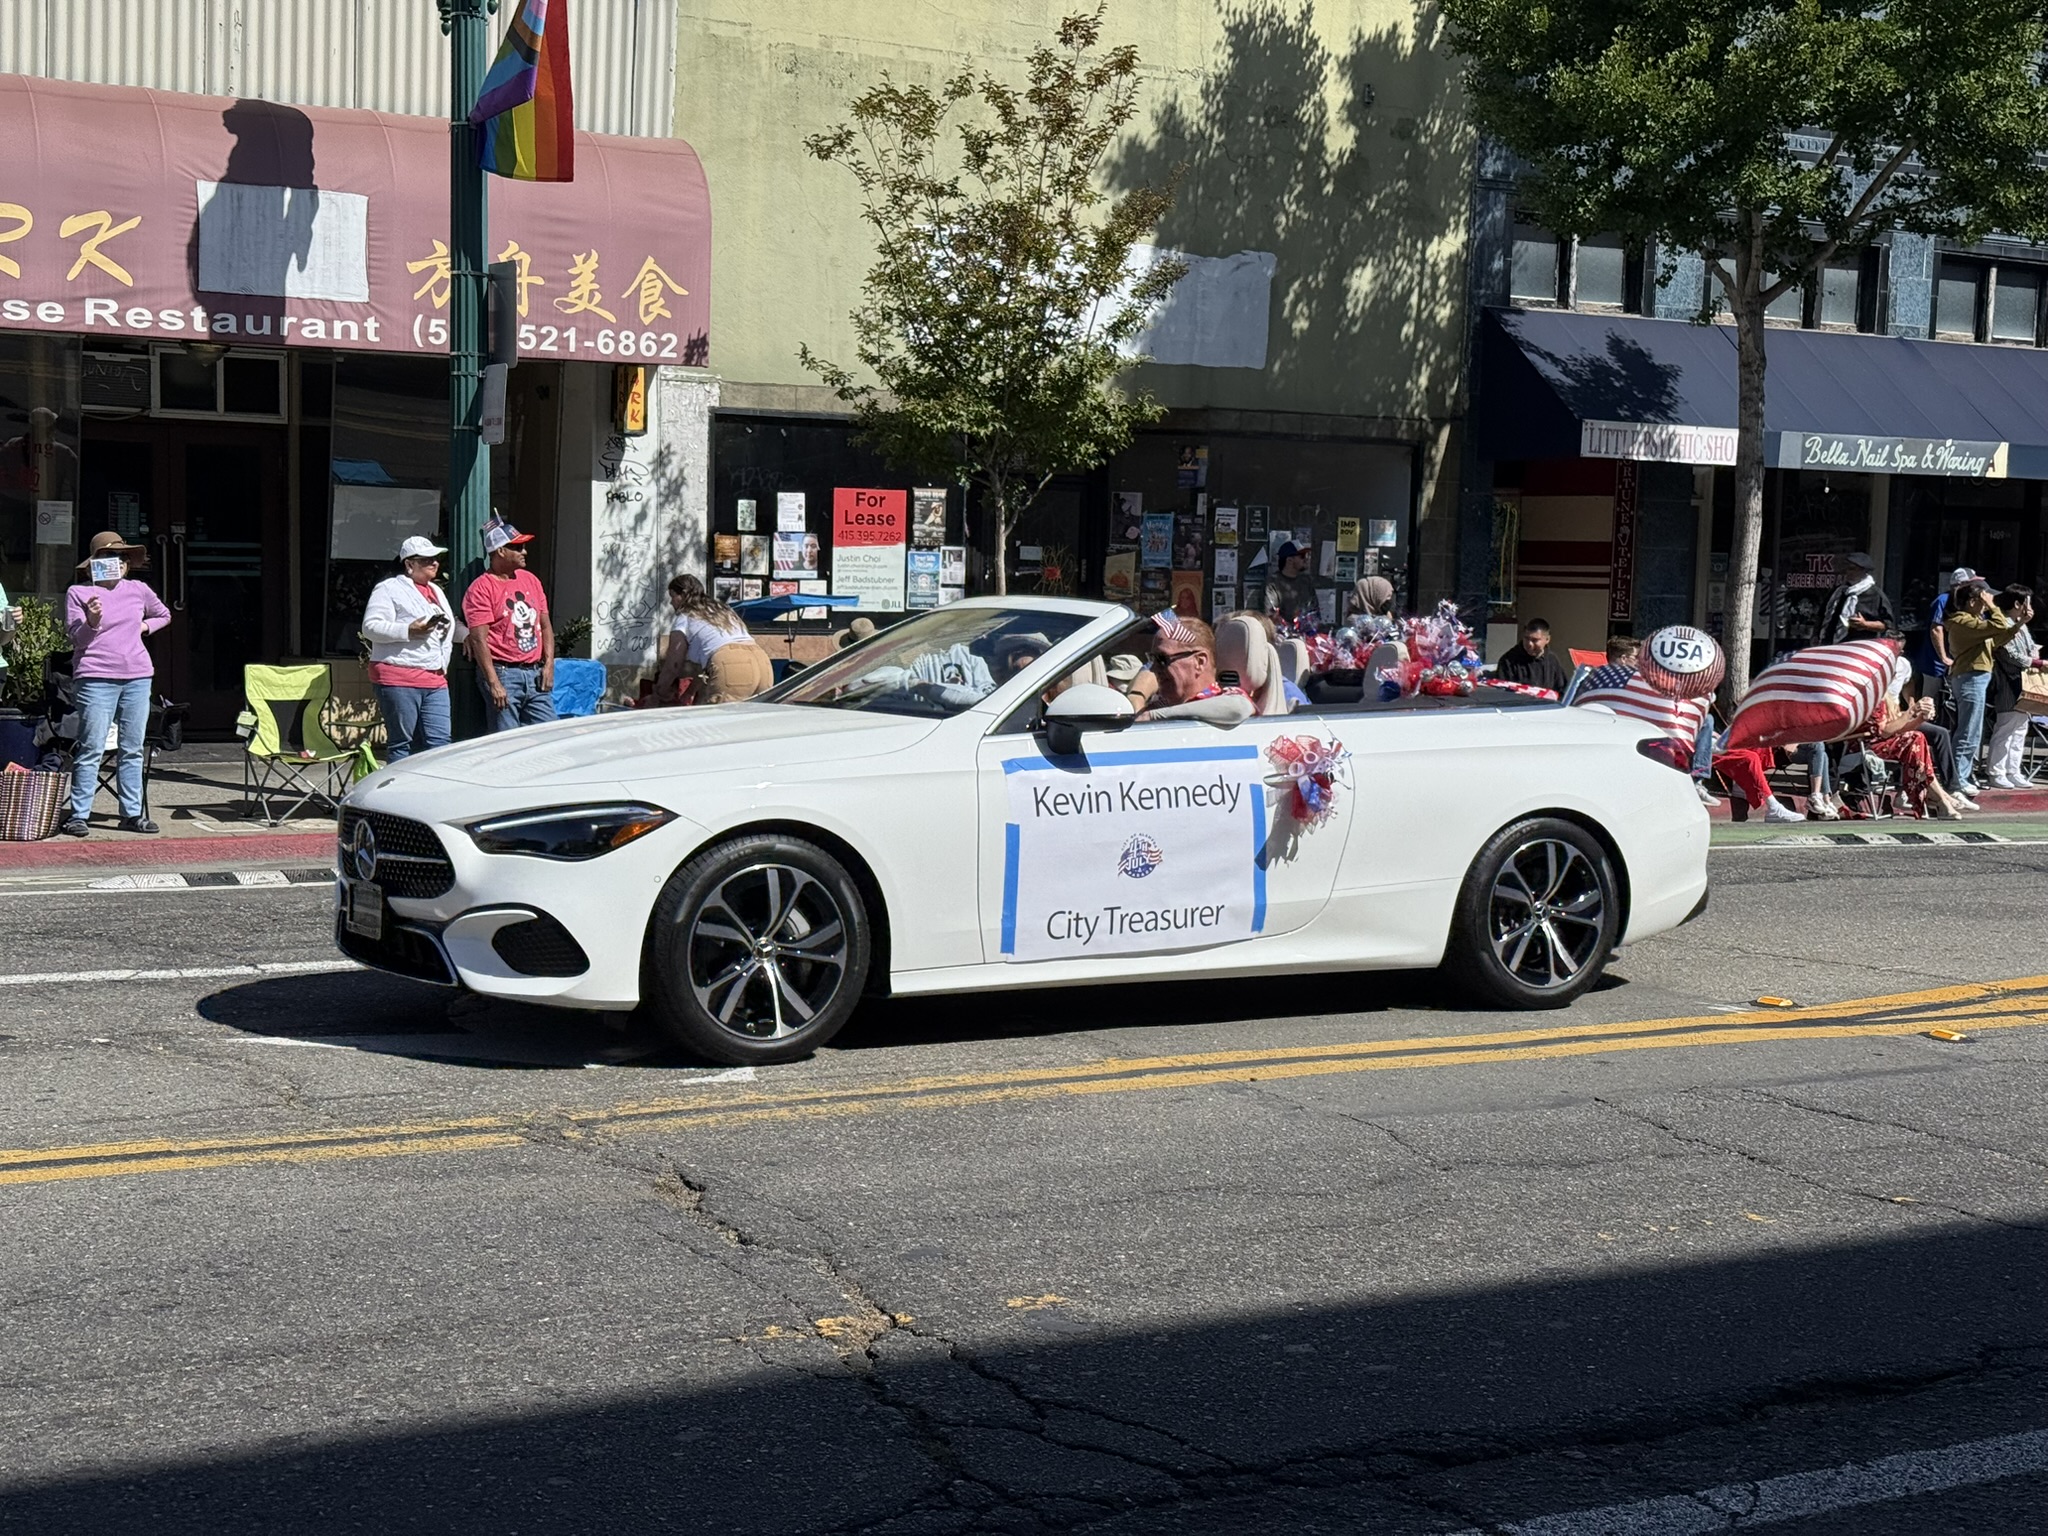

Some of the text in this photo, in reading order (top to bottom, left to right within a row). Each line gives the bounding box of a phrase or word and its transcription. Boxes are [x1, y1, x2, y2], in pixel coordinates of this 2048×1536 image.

[84, 297, 381, 342] Restaurant
[518, 324, 678, 358] 521-6862
[1643, 430, 1703, 460] PSYCHIC
[1706, 435, 1735, 462] SHO
[1805, 436, 1986, 476] Bella Nail Spa & Waxing
[856, 491, 886, 507] For
[844, 509, 896, 526] Lease
[838, 530, 902, 542] 415.395.7262
[836, 554, 881, 563] Justin Choi
[1805, 553, 1835, 573] TK
[836, 575, 851, 584] Jeff
[1615, 547, 1629, 611] TELLER
[1786, 573, 1815, 588] BARBER
[1816, 574, 1836, 589] SHOP
[890, 600, 902, 609] JLL
[1660, 640, 1703, 662] USA
[1033, 774, 1241, 818] Kevin Kennedy
[1126, 855, 1151, 871] JULY
[1047, 903, 1225, 945] City Treasurer
